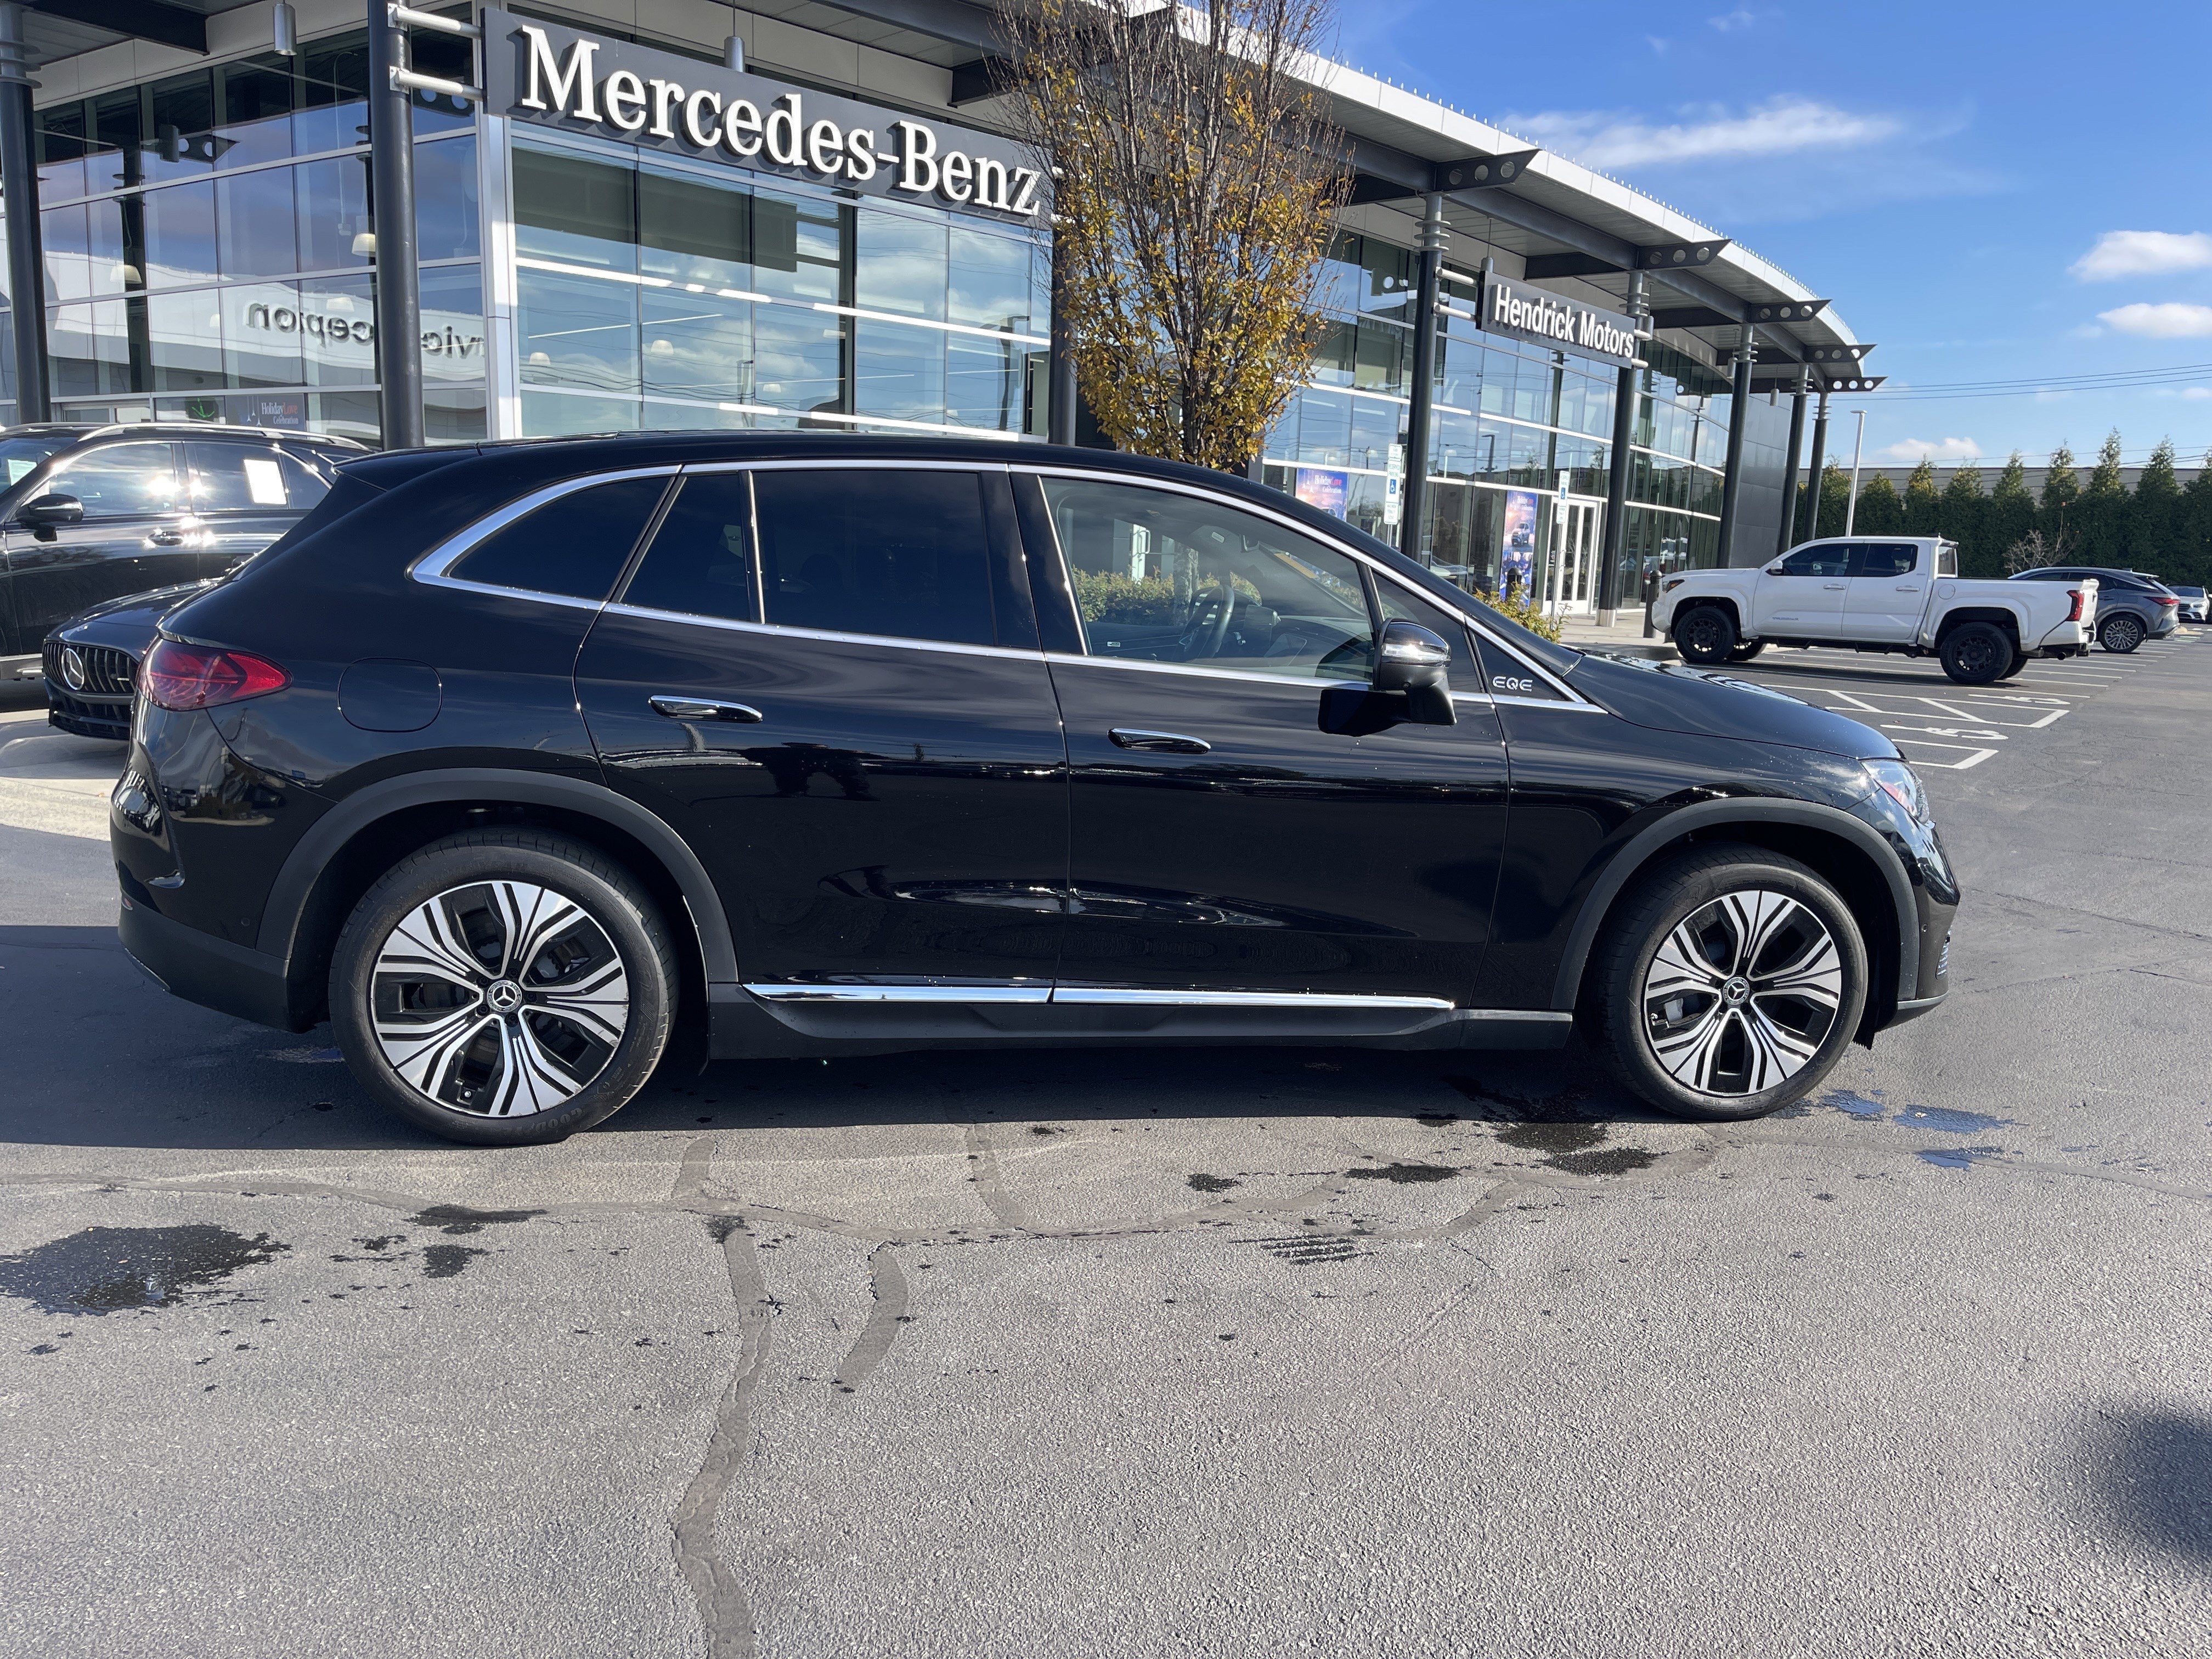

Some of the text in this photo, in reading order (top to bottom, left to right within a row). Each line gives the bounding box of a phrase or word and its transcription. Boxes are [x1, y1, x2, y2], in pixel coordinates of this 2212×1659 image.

[522, 25, 1041, 216] Mercedes-Benz
[1494, 284, 1634, 358] Hendrick Motors
[273, 416, 299, 425] Celebration
[1492, 676, 1533, 692] EQE
